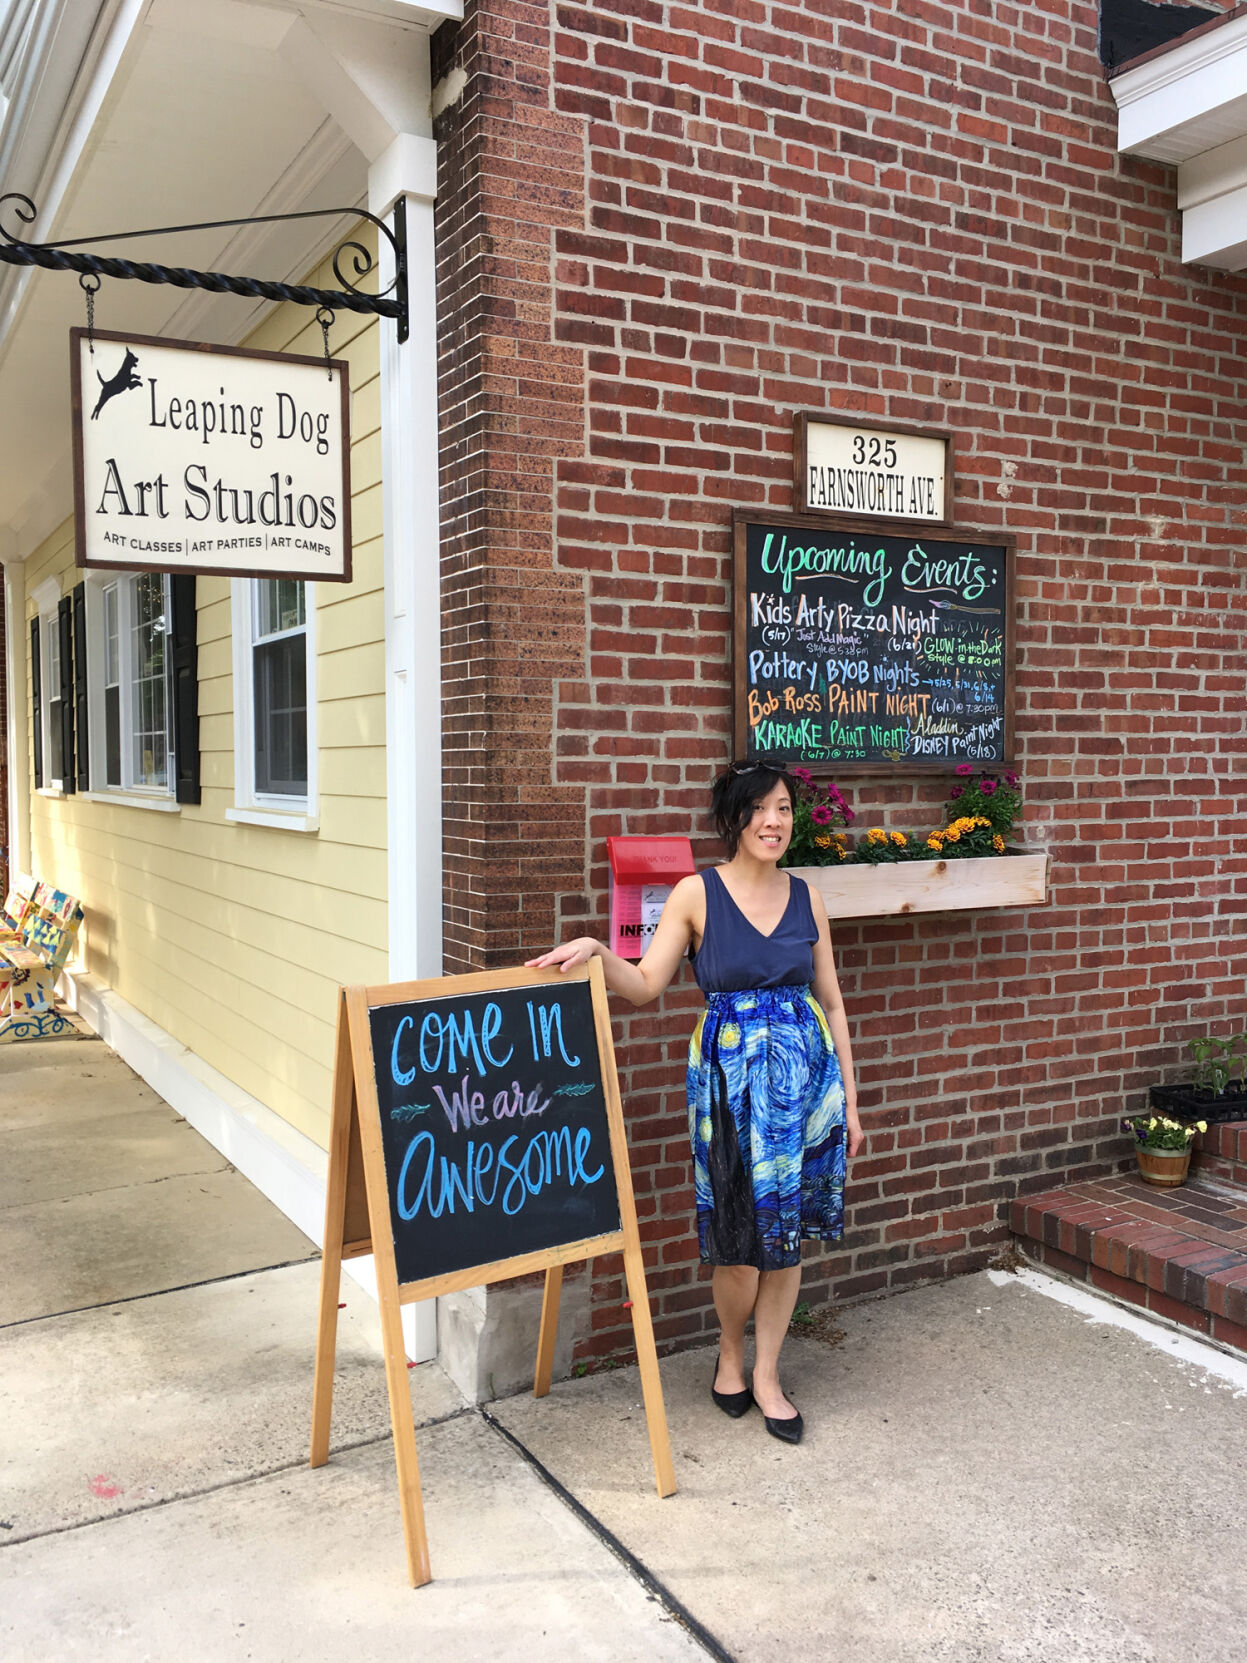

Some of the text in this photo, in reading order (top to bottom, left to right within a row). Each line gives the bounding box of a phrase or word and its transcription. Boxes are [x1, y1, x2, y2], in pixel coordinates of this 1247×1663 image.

[147, 378, 329, 455] Leaping Dog
[852, 435, 897, 468] 325
[96, 458, 336, 530] Art Studios
[809, 466, 938, 516] FARNSWORTH AVE.
[104, 531, 331, 556] ART CLASSES ART PARTIES ART CAMPS
[761, 533, 998, 607] Upcoming Events:
[750, 592, 940, 639] Kids Arty Pizza Night
[749, 650, 817, 691] Pottery
[826, 658, 869, 685] BYOB
[873, 657, 919, 692] Nights
[748, 688, 779, 726] Bob
[783, 686, 822, 715] Ross
[911, 712, 964, 736] Aladdin
[754, 718, 822, 751] KARAOKE
[911, 735, 949, 756] DISNEY
[432, 1075, 553, 1133] We are
